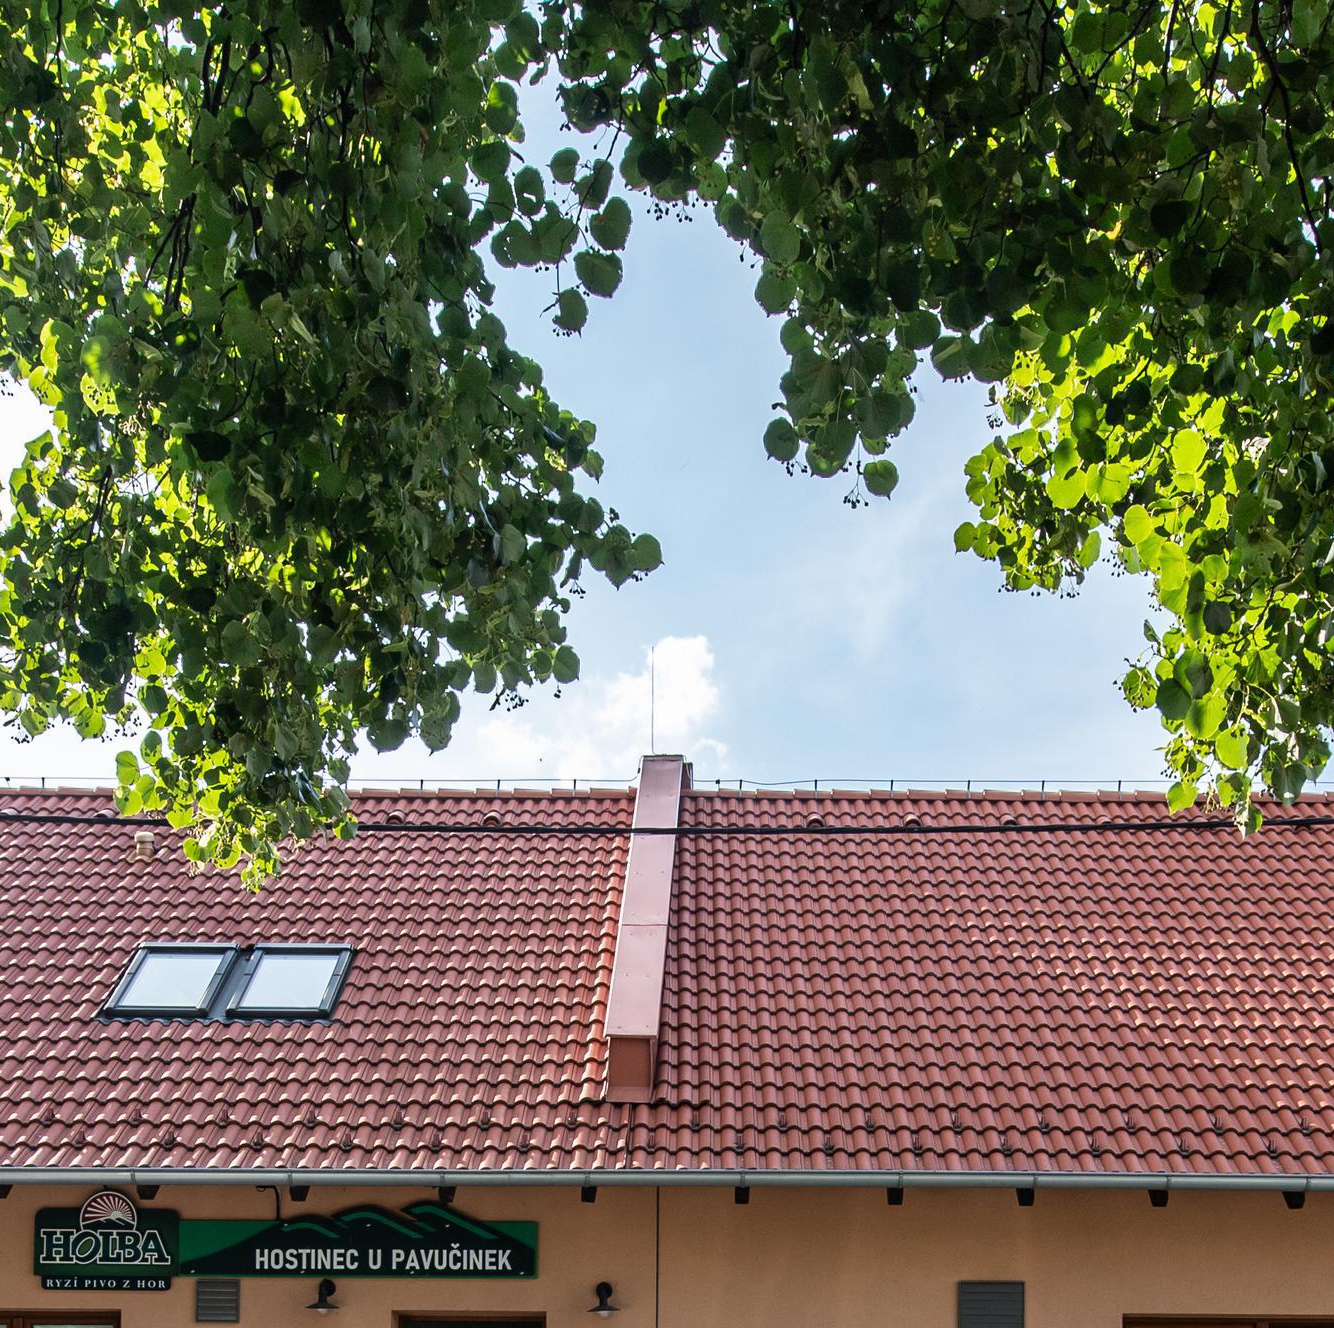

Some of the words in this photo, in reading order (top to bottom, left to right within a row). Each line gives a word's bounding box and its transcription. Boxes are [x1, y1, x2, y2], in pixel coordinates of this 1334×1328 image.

[40, 1229, 171, 1265] HOLBA
[255, 1248, 359, 1271] HOSTINEC
[368, 1248, 382, 1271] U
[391, 1242, 513, 1271] PAVUČINEK
[46, 1276, 78, 1288] RYZÍ
[84, 1279, 116, 1288] PIVO
[122, 1279, 131, 1288] Z
[137, 1279, 166, 1289] HOR
